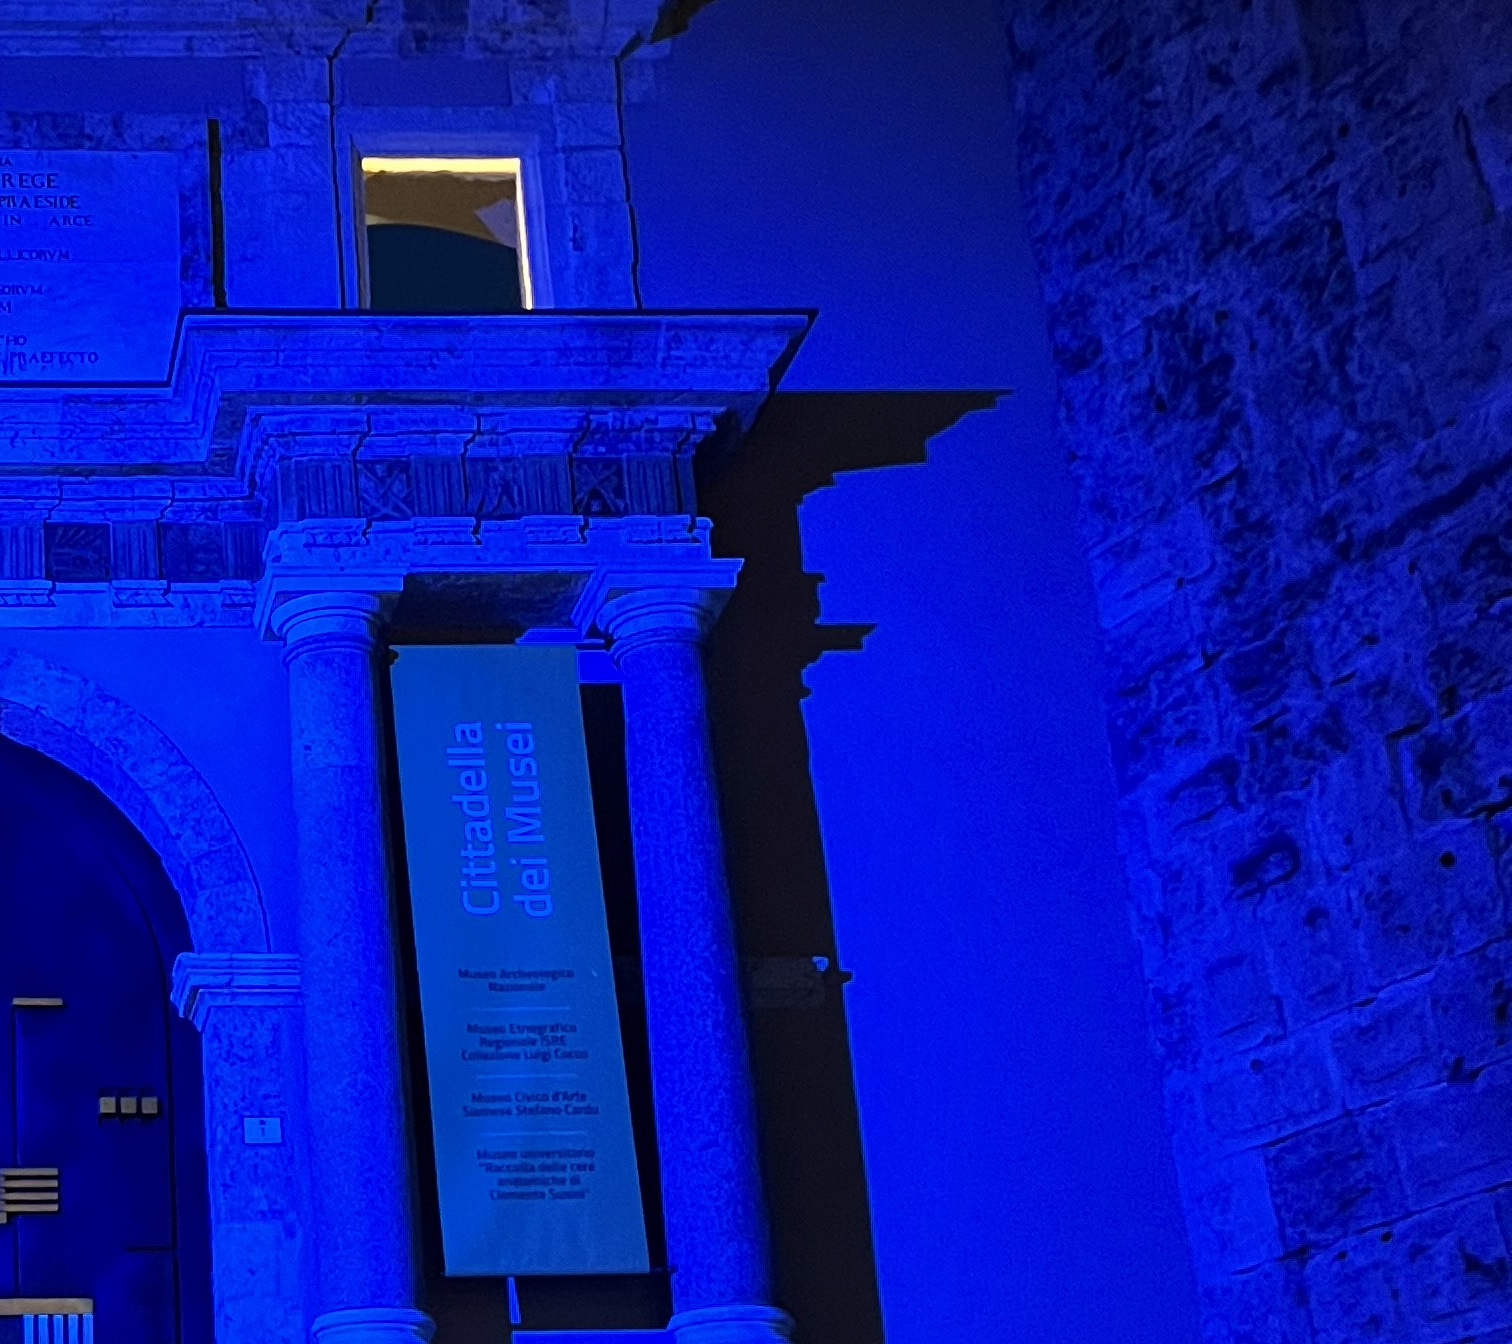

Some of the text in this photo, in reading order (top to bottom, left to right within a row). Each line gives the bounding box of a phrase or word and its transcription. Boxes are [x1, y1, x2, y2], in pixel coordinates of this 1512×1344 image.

[1, 172, 60, 189] REGE
[3, 213, 22, 226] IN
[48, 213, 96, 227] ARCE
[446, 721, 501, 915] Cittadella
[495, 722, 554, 919] dei Musei
